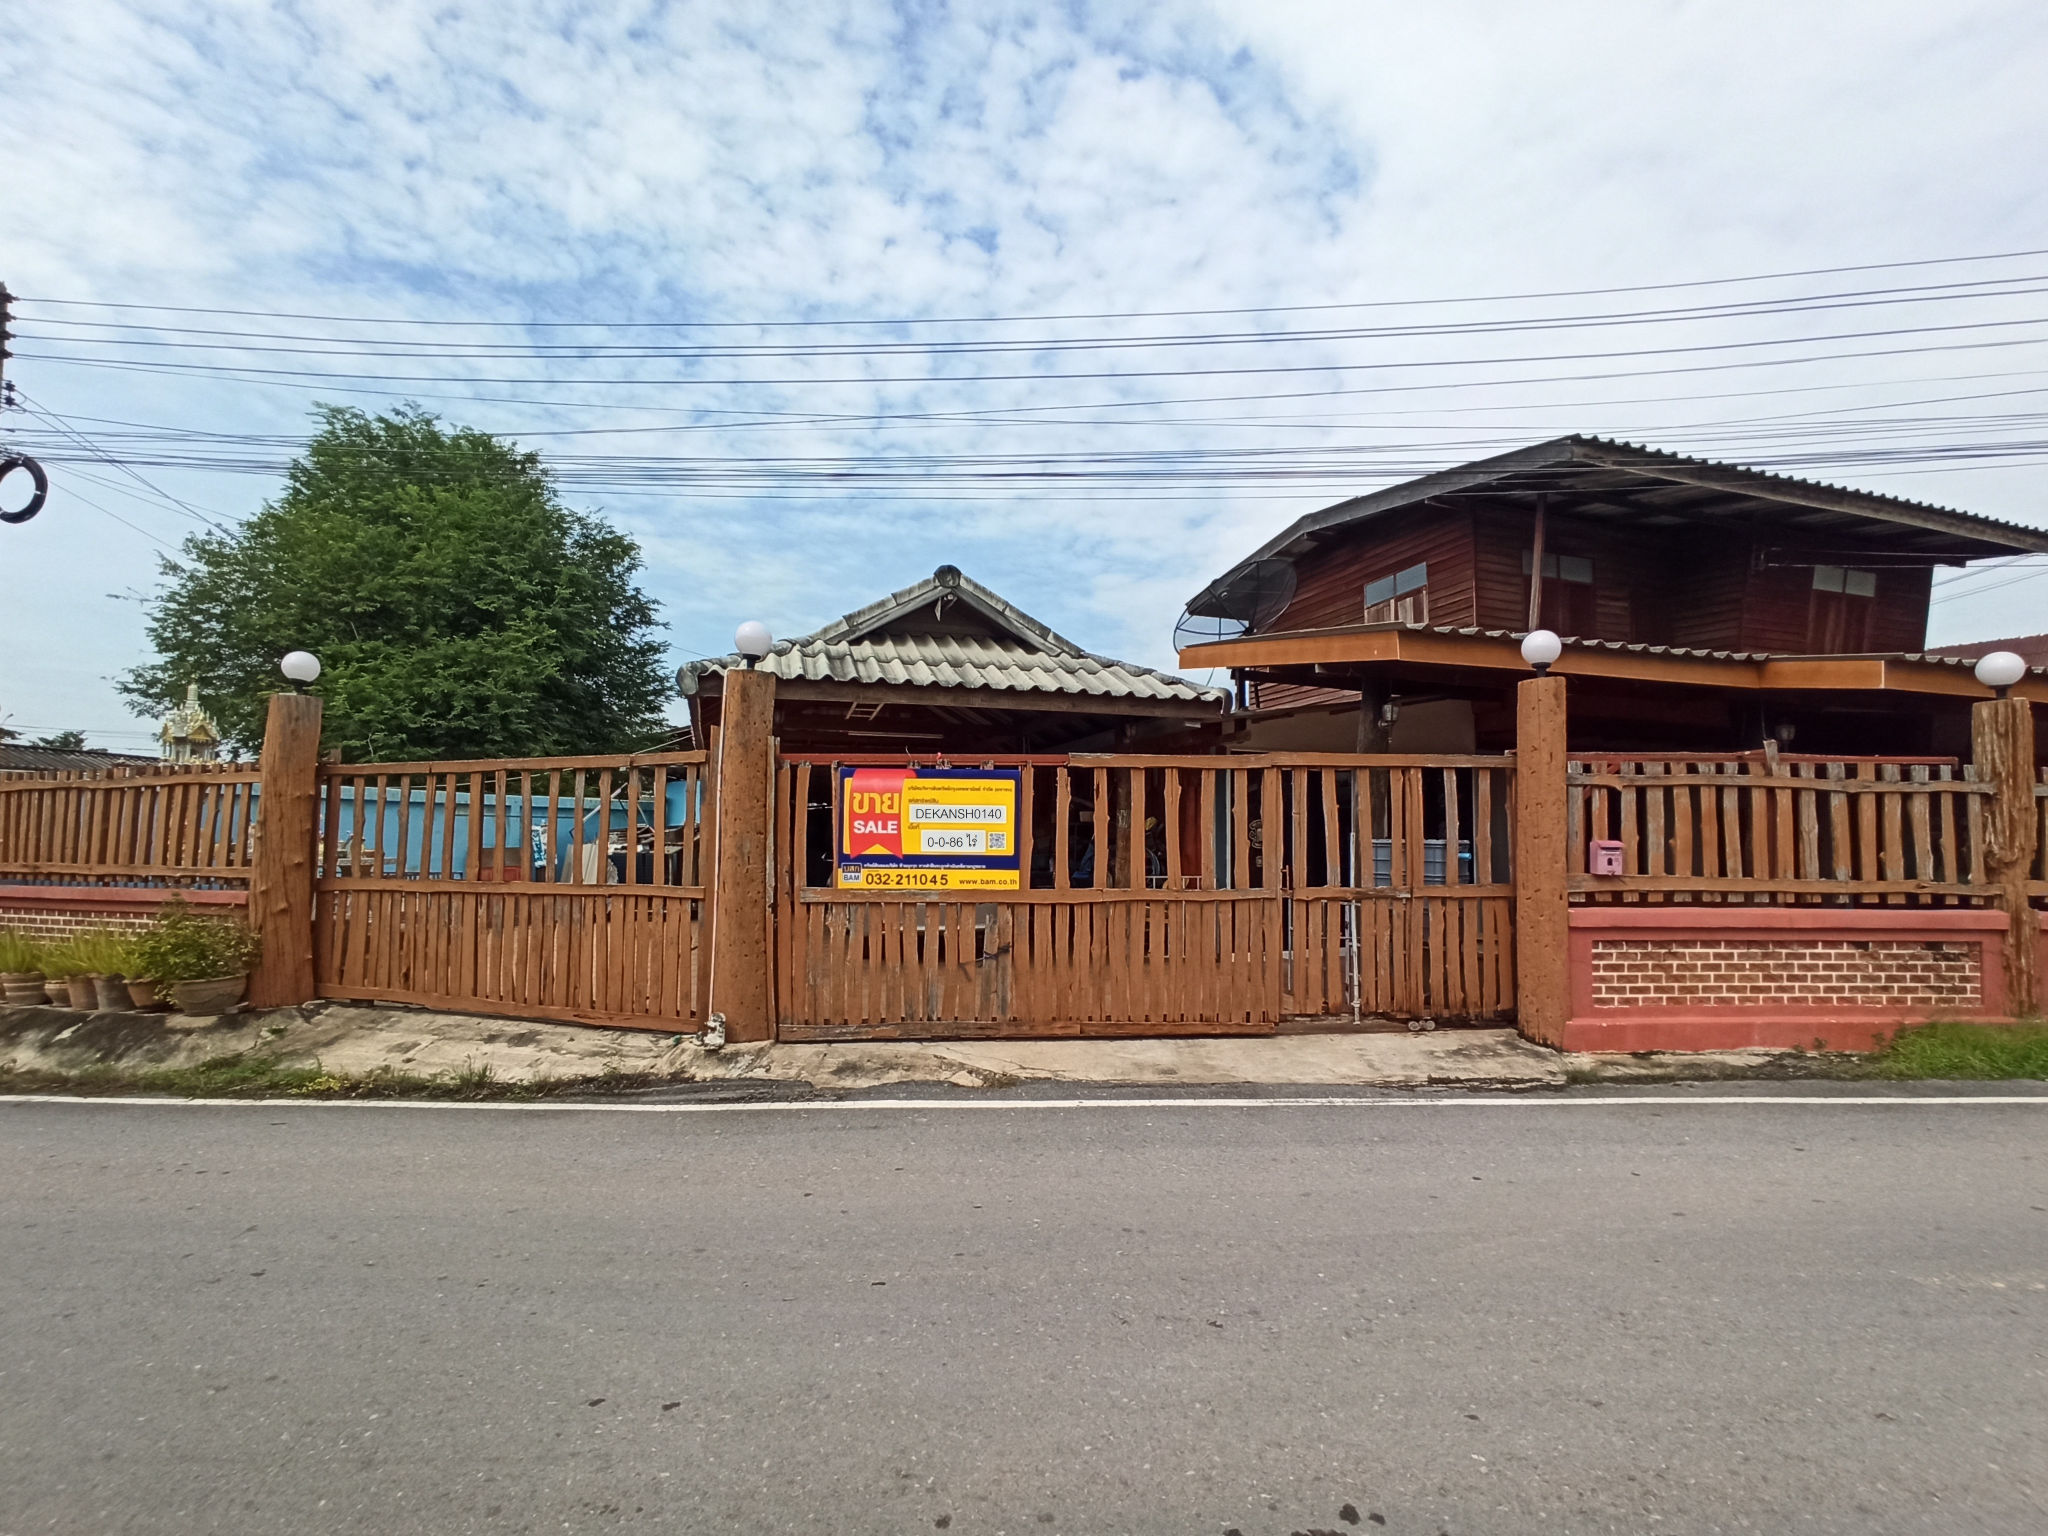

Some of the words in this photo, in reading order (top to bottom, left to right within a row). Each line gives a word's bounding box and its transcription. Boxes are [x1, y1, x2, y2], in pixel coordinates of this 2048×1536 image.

[853, 792, 900, 814] ขาย
[915, 808, 1002, 820] DEKANSH0140
[853, 820, 898, 834] SALE
[927, 836, 964, 848] 0-0-86
[865, 873, 949, 886] 032-211045
